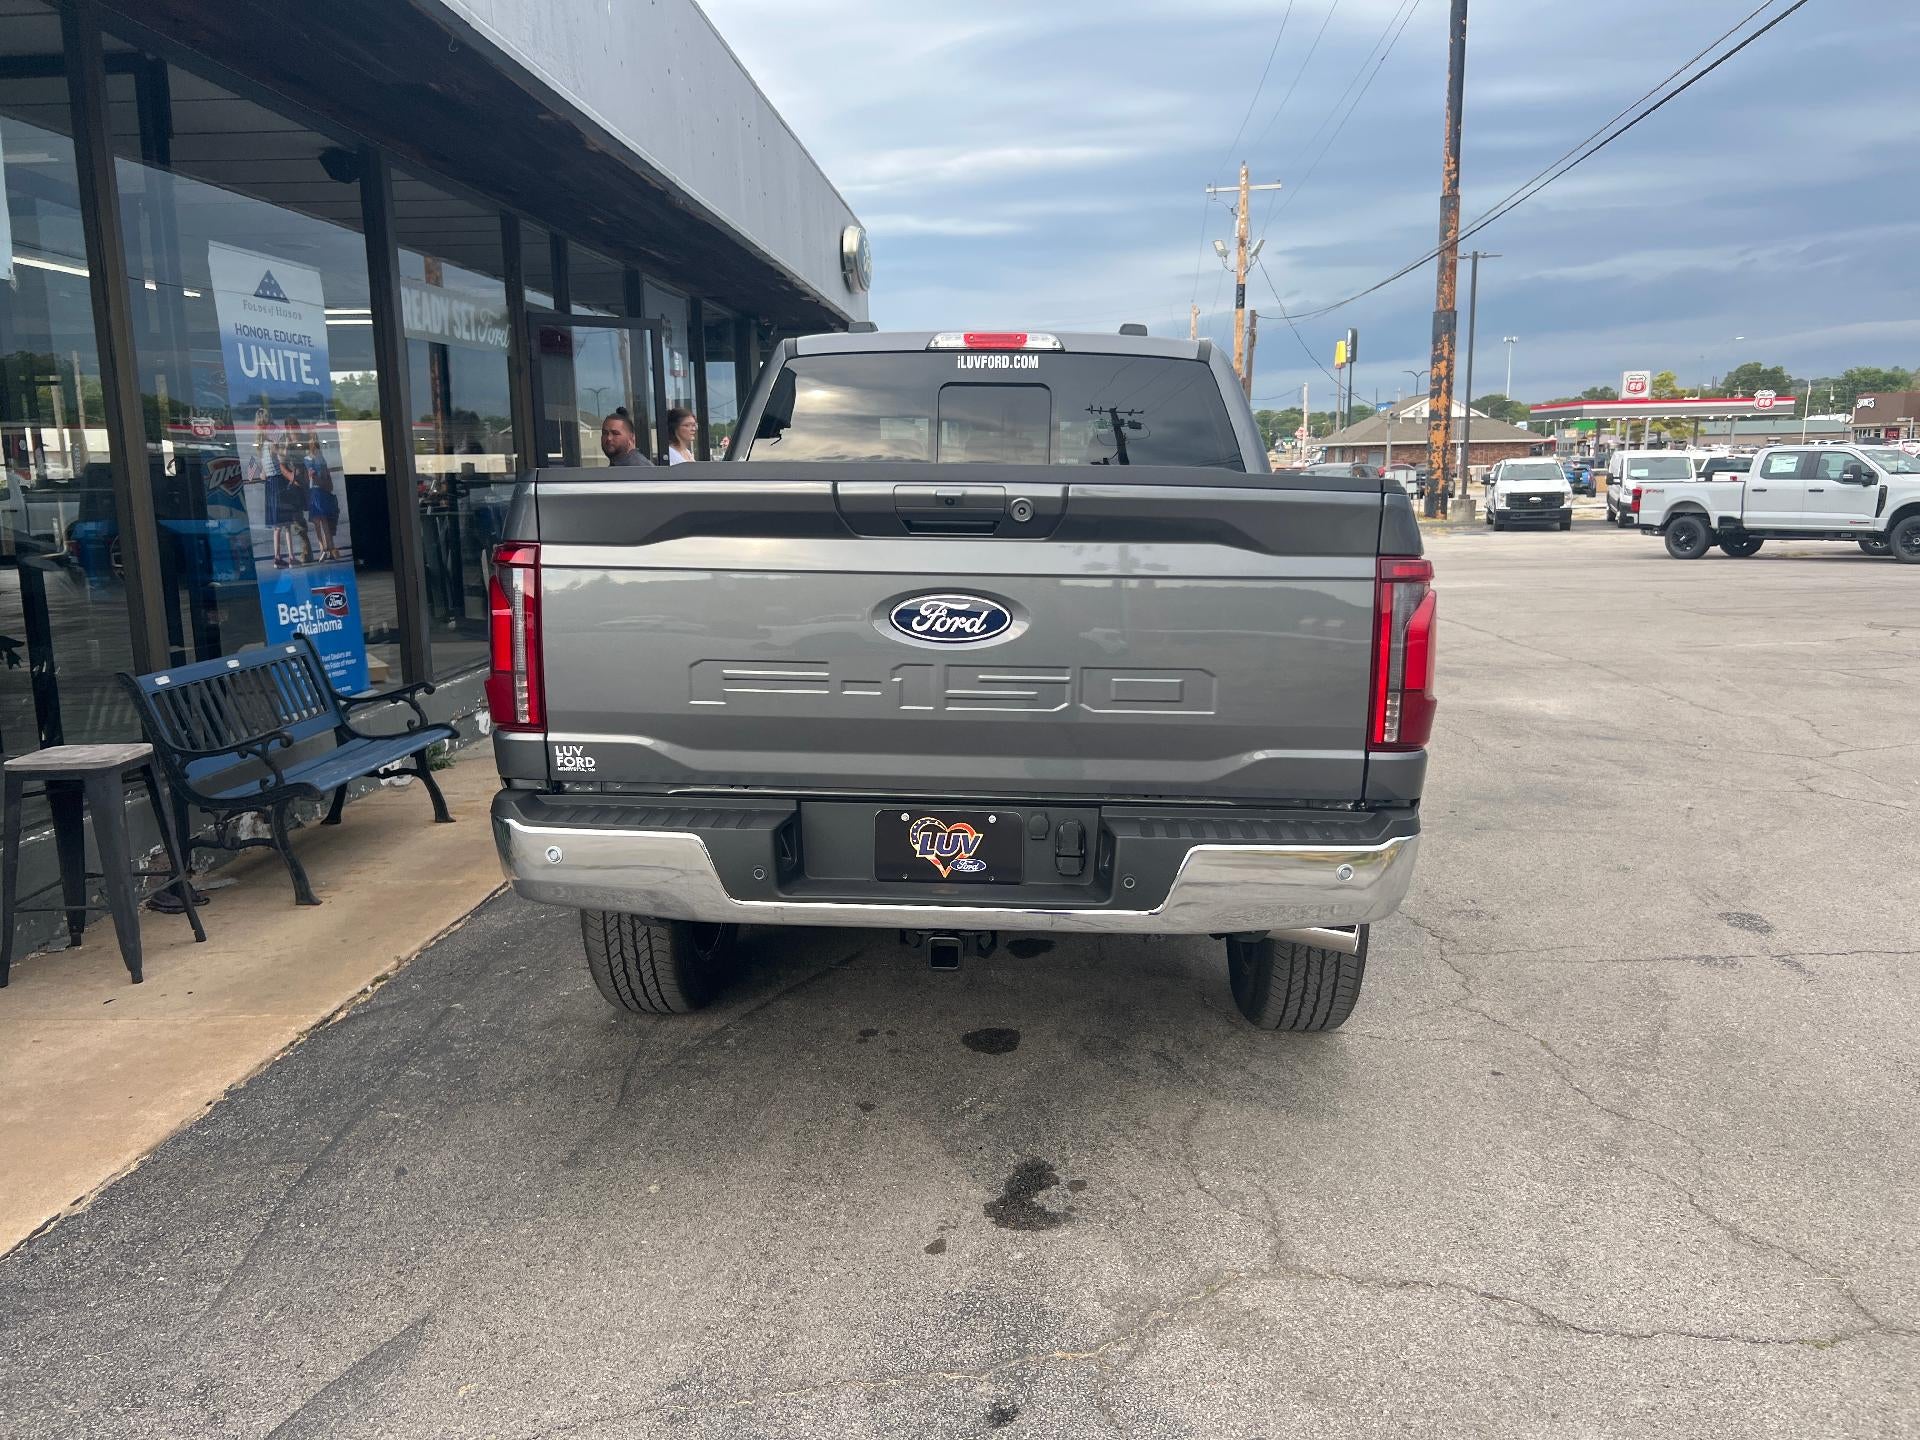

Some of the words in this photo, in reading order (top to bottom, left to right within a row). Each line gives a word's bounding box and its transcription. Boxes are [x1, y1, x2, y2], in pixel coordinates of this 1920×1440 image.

[451, 299, 477, 341] SET
[478, 308, 511, 349] Ford
[273, 330, 315, 348] EDUCATE.
[237, 343, 320, 386] UNITE.
[957, 355, 1039, 369] iLUVFORD.COM
[277, 600, 314, 625] Best
[315, 604, 325, 620] in
[911, 600, 989, 633] Ford
[297, 618, 343, 636] Oklahoma
[689, 659, 1216, 715] F-150
[555, 745, 584, 757] LUV
[557, 756, 596, 768] FORD
[916, 832, 984, 858] LUV
[956, 860, 980, 871] Ford
